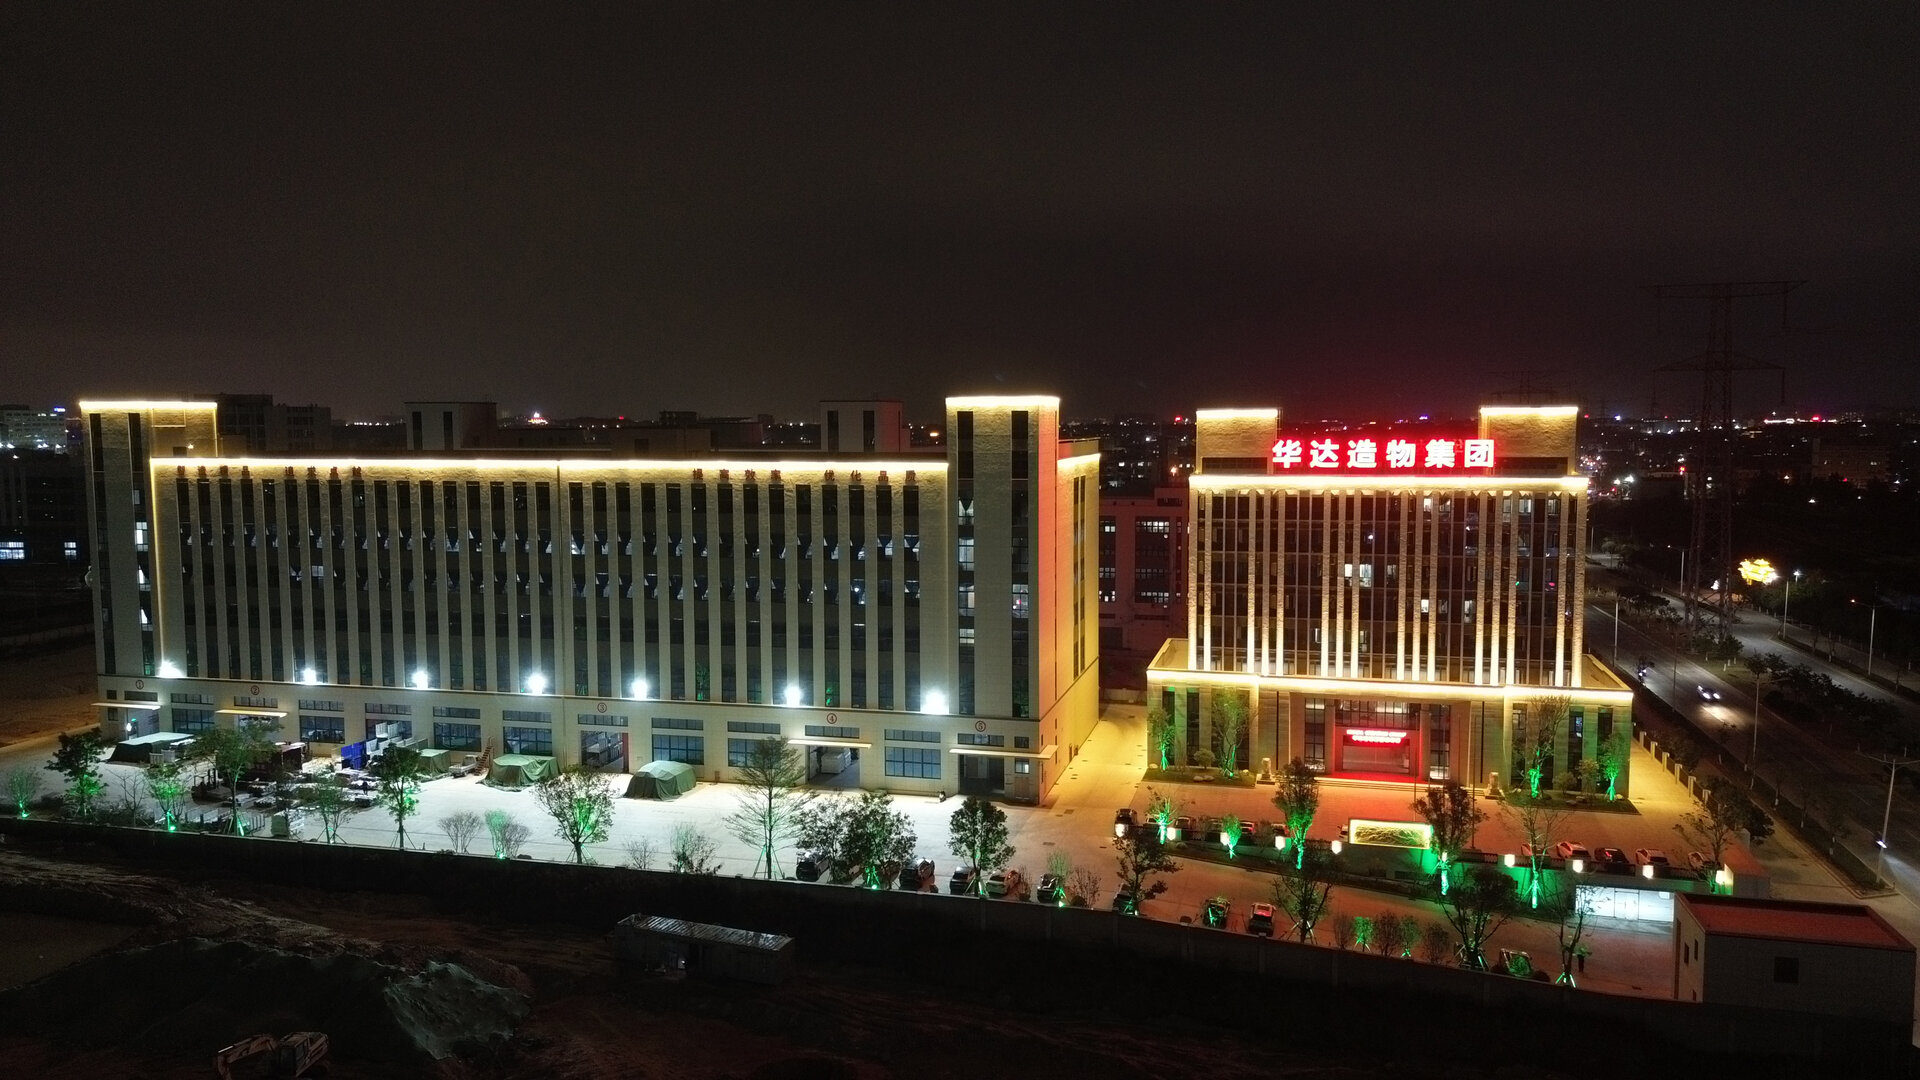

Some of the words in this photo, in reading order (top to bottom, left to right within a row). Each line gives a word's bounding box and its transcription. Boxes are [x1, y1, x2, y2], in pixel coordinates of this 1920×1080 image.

[1272, 439, 1495, 468] 华达造物集团
[692, 468, 782, 481] 提高效率
[824, 469, 917, 482] 优化品质
